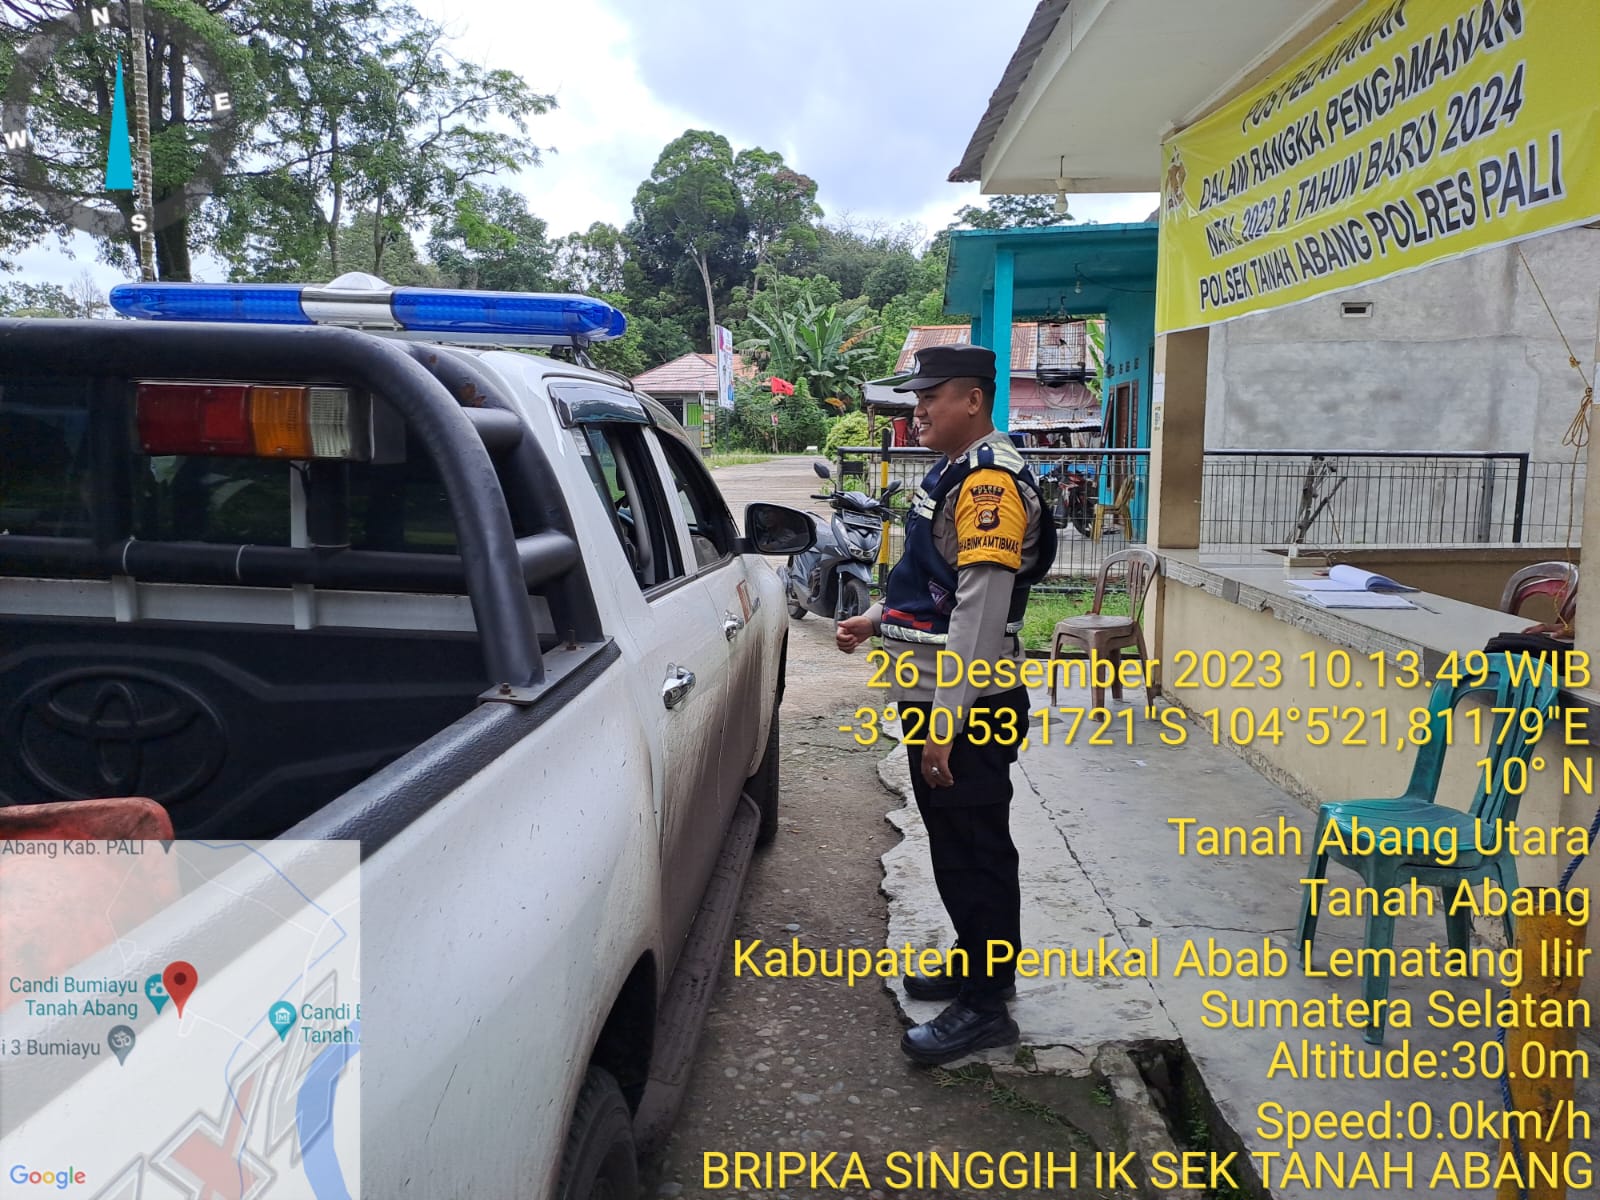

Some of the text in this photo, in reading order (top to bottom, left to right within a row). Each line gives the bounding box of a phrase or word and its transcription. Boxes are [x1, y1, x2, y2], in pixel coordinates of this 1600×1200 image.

[1199, 0, 1522, 211] DALAM RANGKA PENGAMANAN
[1241, 196, 1277, 242] 2023
[1277, 188, 1291, 228] &
[1295, 151, 1362, 220] TAHUN
[1363, 108, 1437, 190] BARU
[1440, 63, 1524, 153] 2024
[1200, 134, 1562, 309] POLSEK TANAH ABANG POLRES PALI
